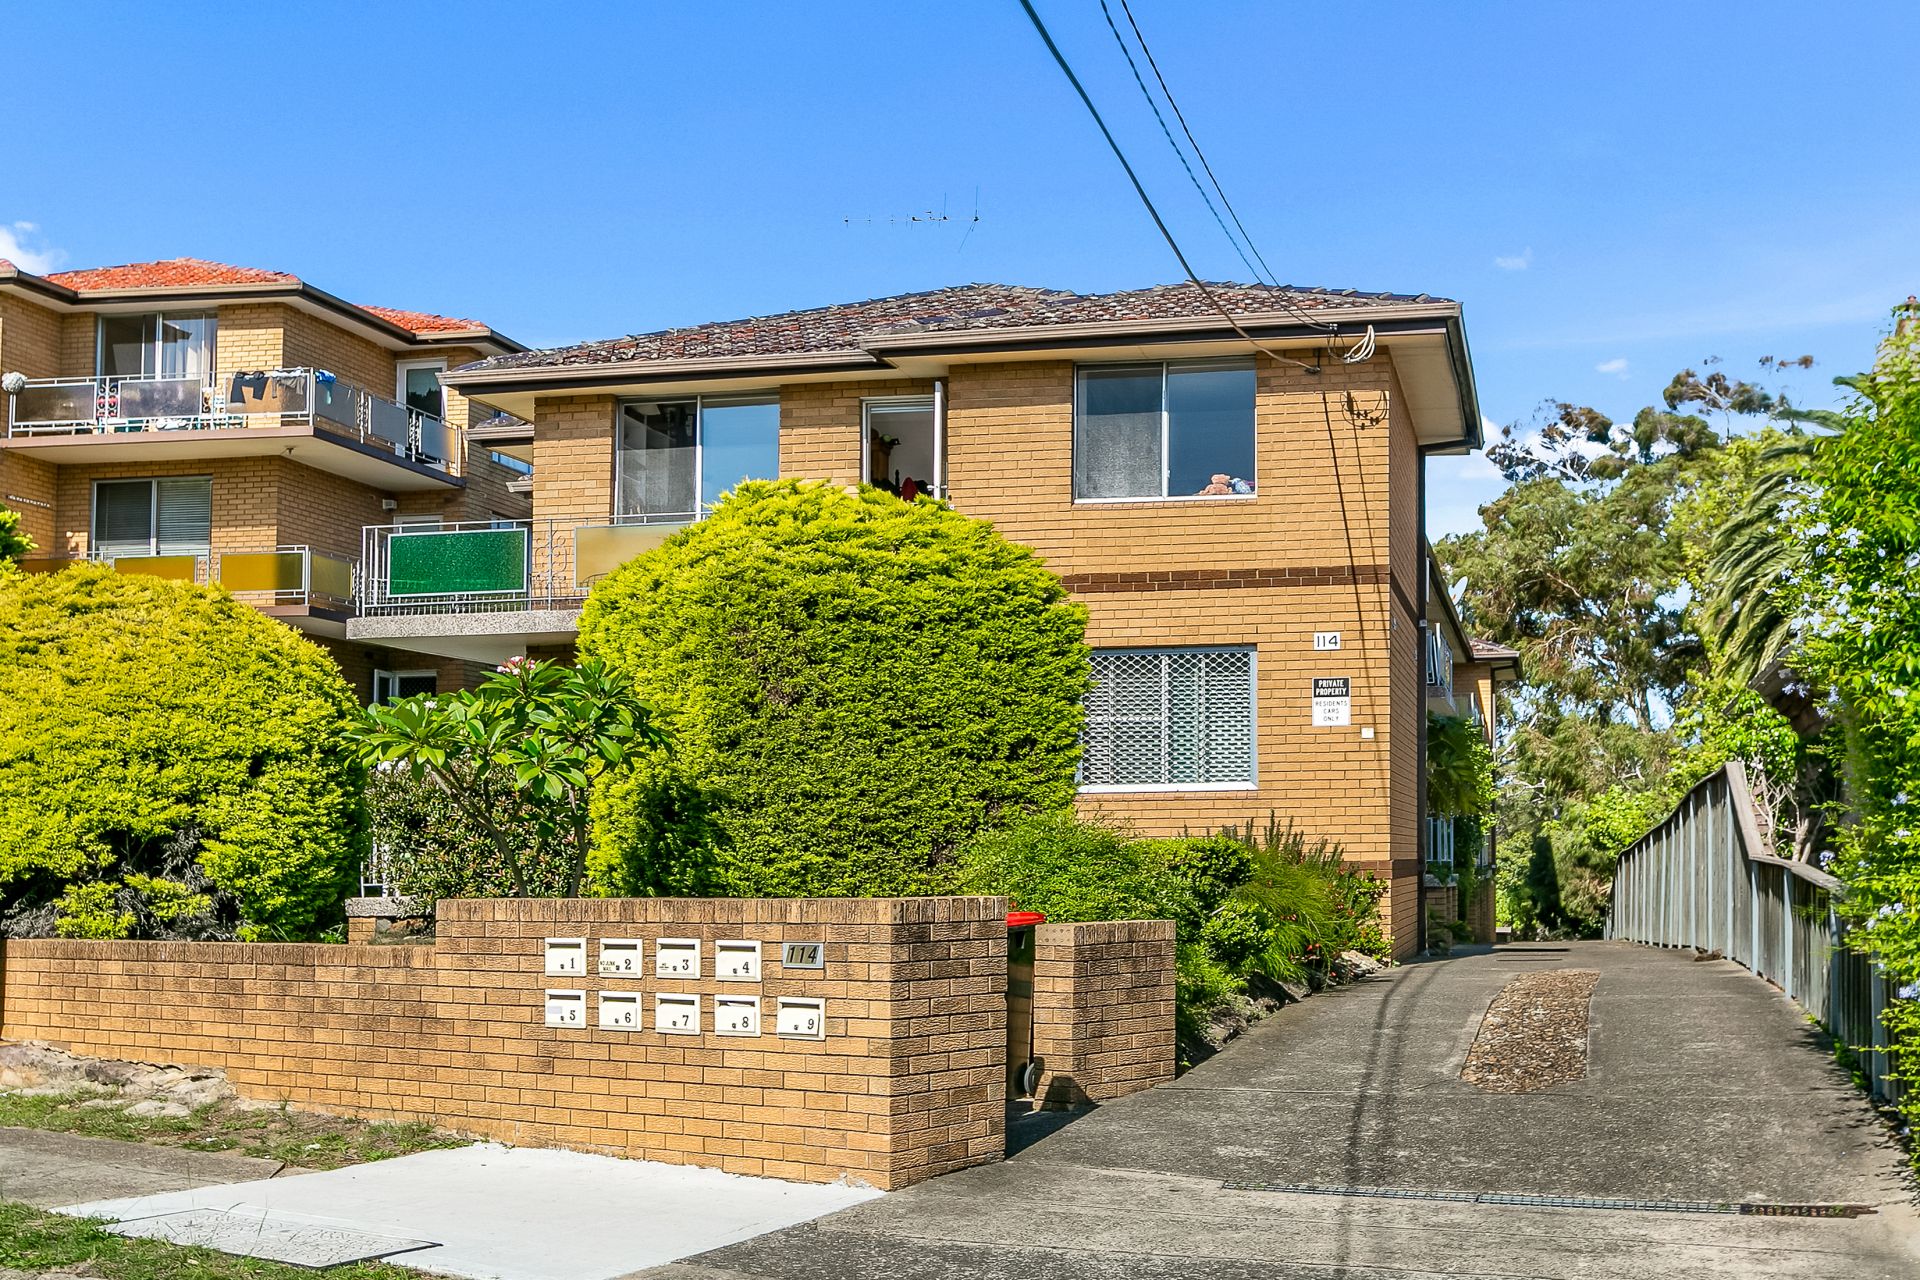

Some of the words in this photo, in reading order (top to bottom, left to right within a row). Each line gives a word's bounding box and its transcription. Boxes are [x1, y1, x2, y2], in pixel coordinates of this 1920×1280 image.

[1317, 635, 1338, 647] 114
[1318, 679, 1344, 687] PRIVATE
[1315, 687, 1347, 696] PROPERTY
[788, 946, 817, 963] 114
[570, 957, 575, 969] 1
[624, 958, 632, 971] 2
[682, 959, 689, 971] 3
[742, 961, 749, 973] 4
[569, 1010, 576, 1021] 5
[625, 1012, 632, 1023] 6
[682, 1015, 689, 1027] 7
[741, 1016, 749, 1028] 8
[807, 1018, 815, 1030] 9
